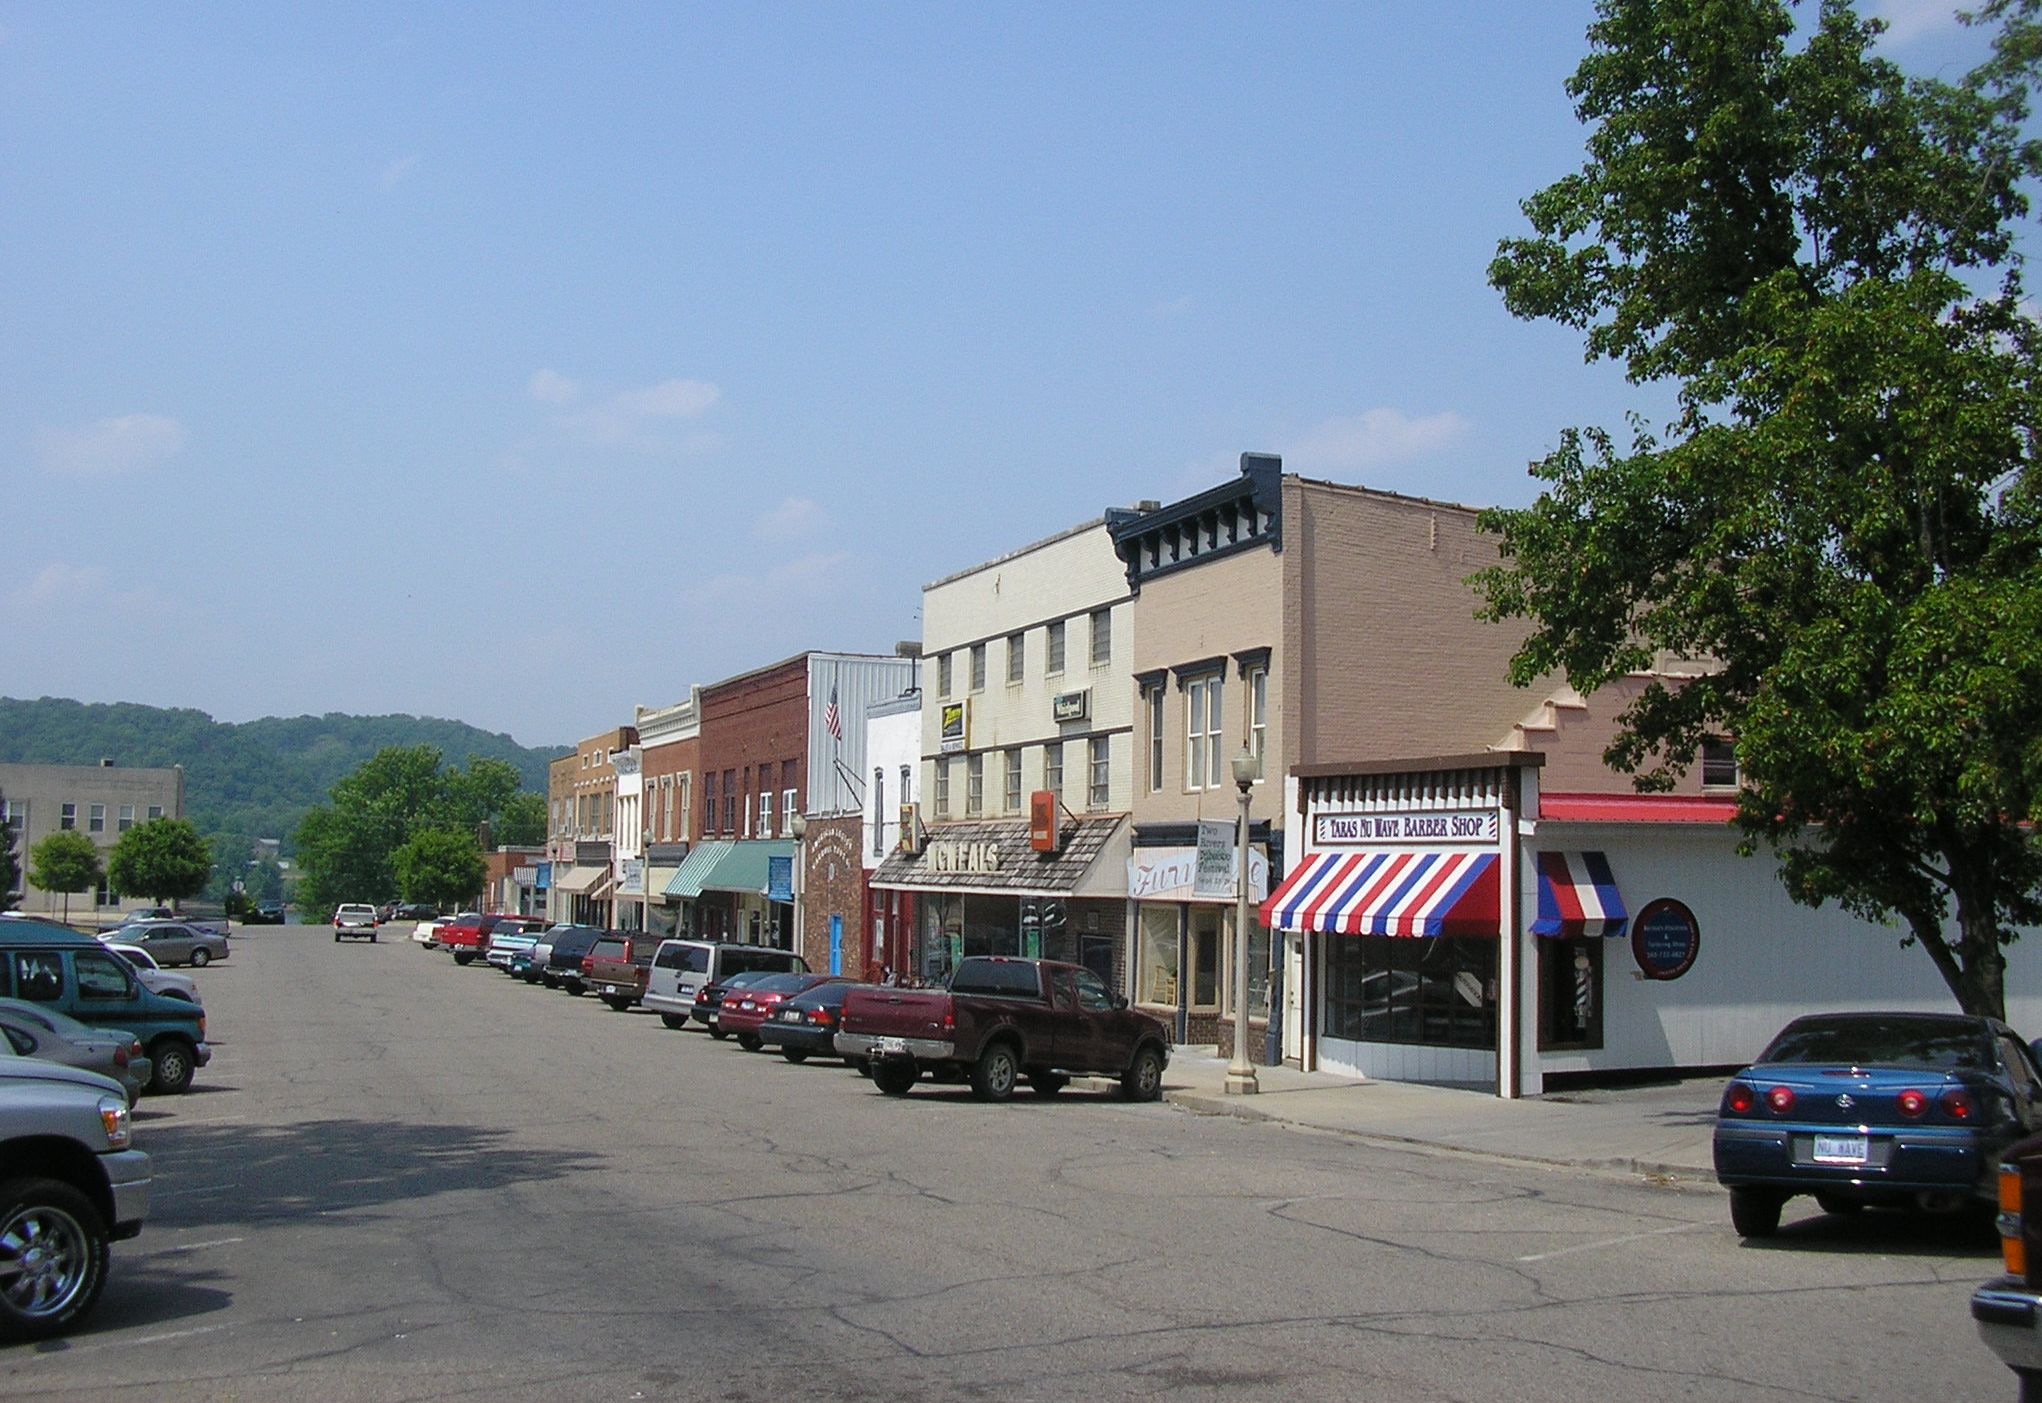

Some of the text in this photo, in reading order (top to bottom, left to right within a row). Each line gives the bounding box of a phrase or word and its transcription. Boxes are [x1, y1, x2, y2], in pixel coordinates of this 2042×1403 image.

[1330, 815, 1483, 838] TARAS NU WAVE BARBER SHOP
[1817, 1140, 1864, 1155] NU WAVE
